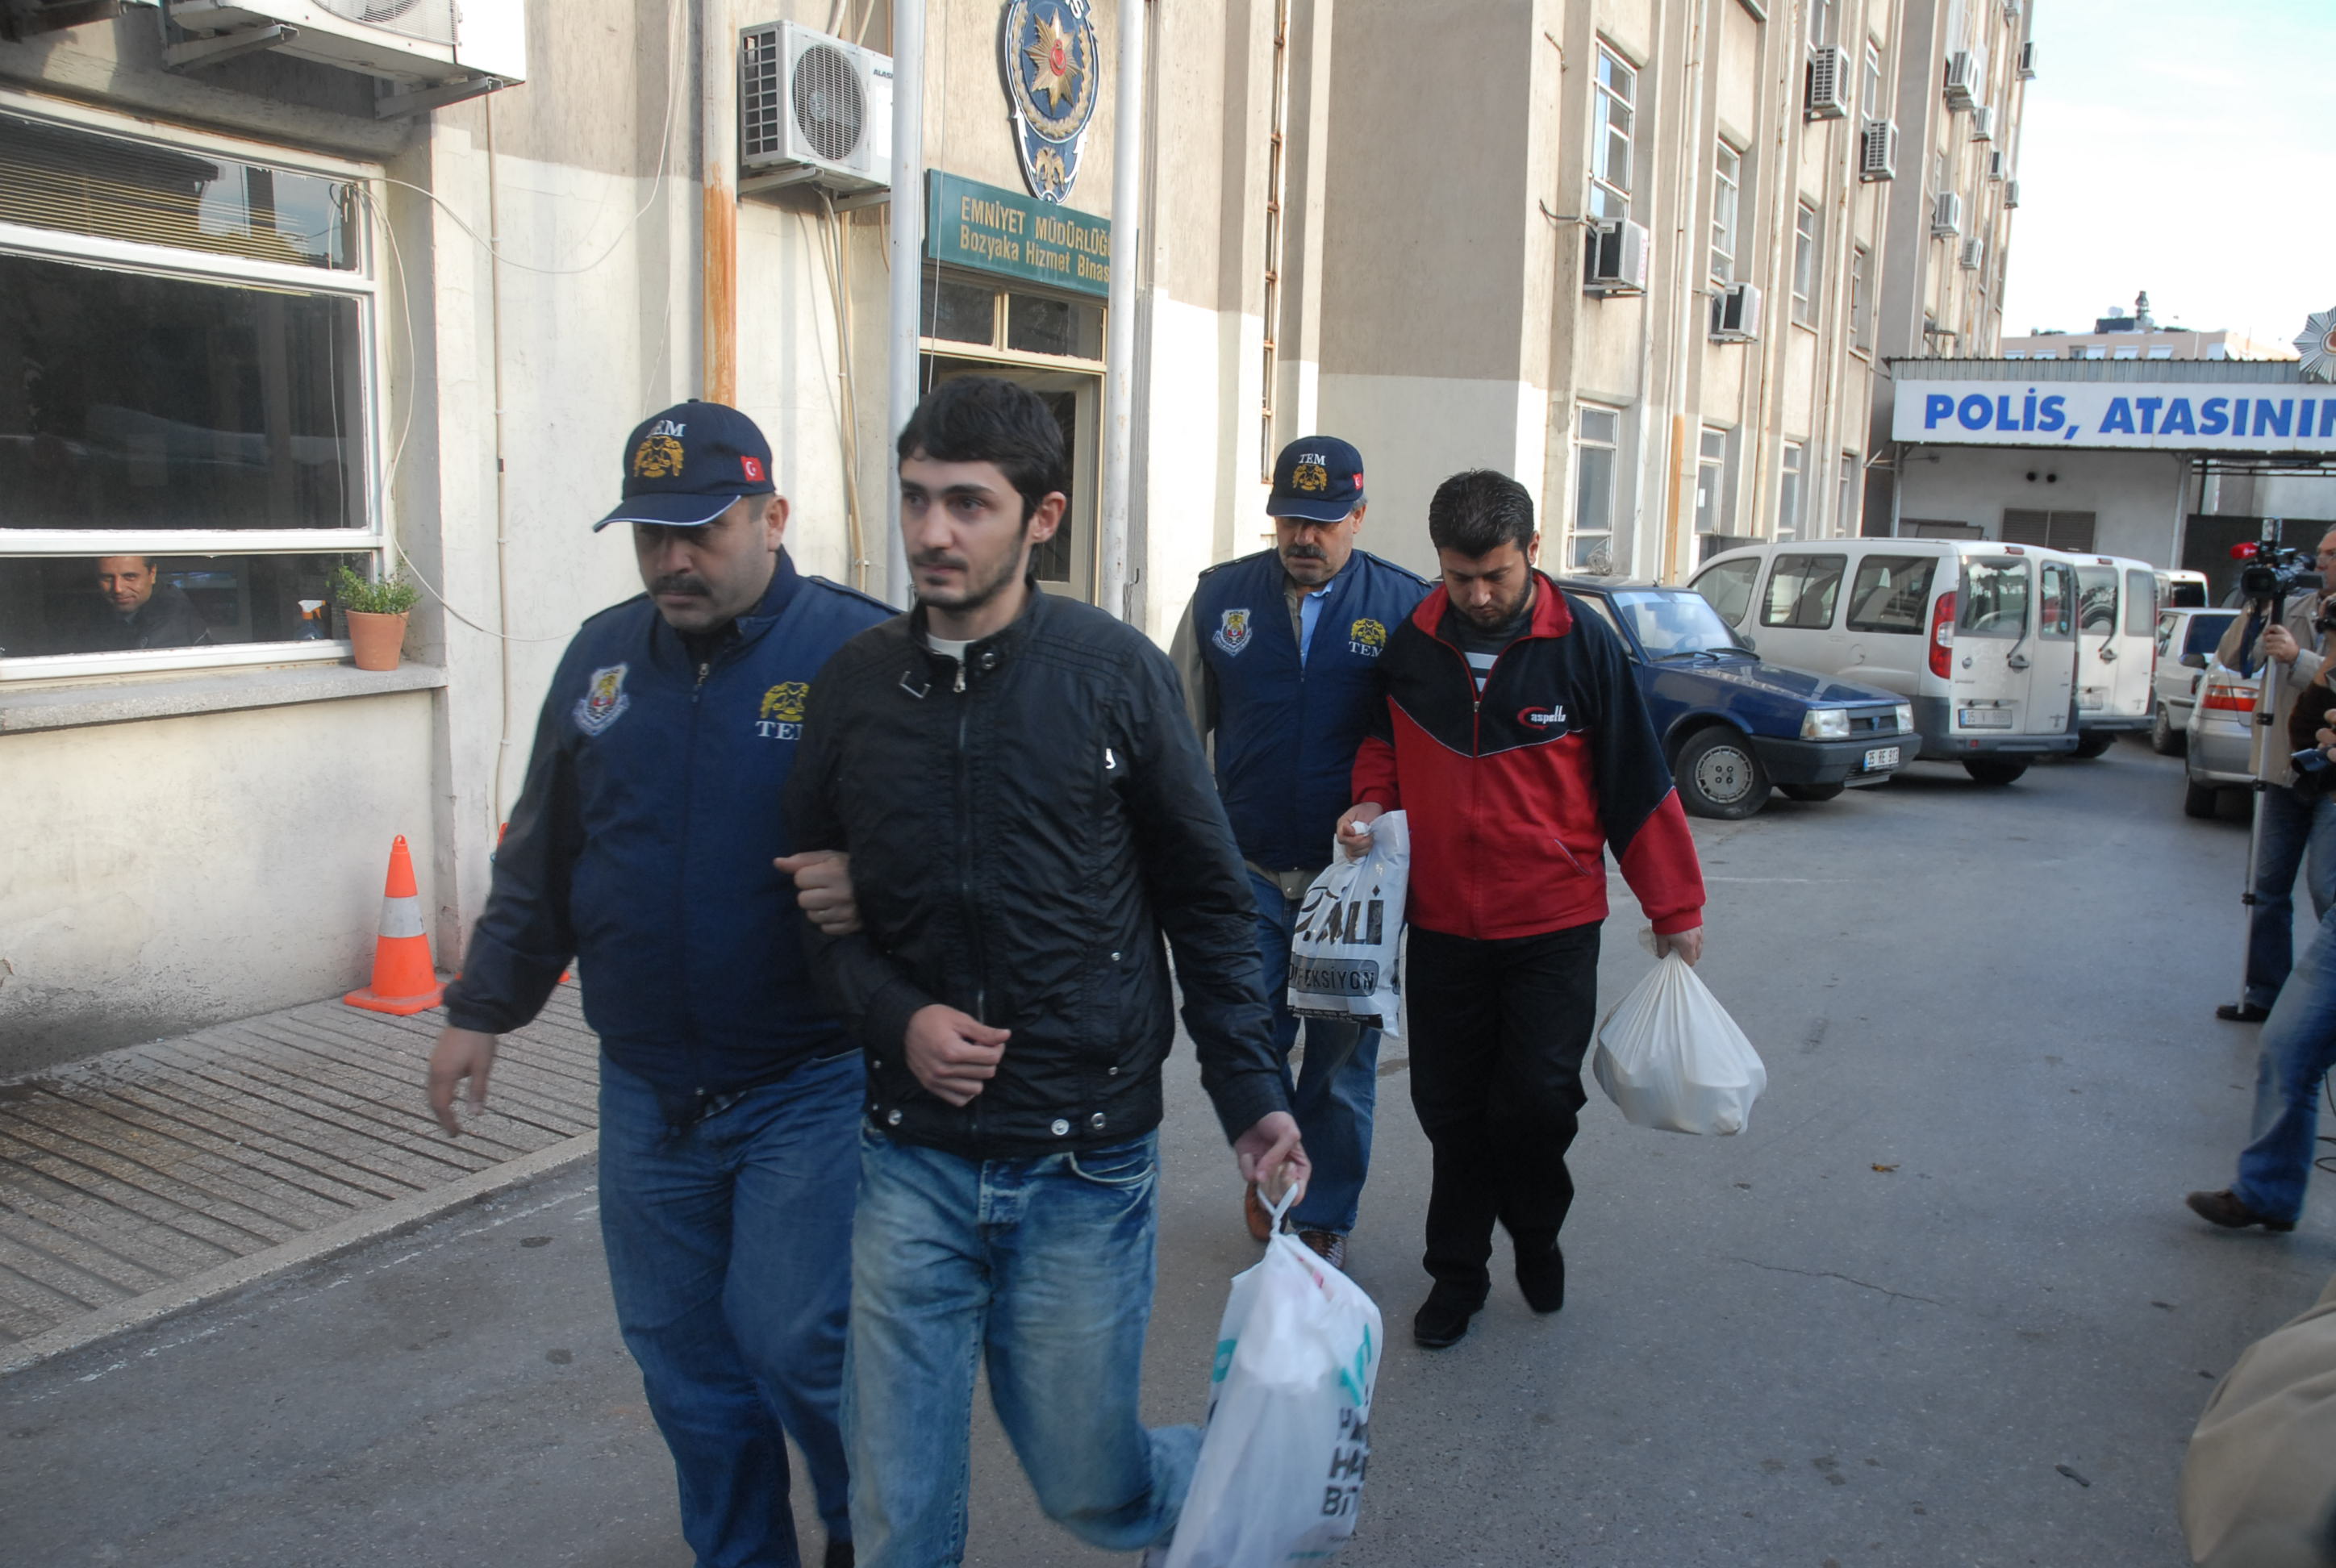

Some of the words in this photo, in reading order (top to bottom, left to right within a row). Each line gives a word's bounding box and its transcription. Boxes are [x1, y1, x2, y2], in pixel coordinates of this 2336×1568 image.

[874, 69, 893, 79] ALAS
[962, 196, 1025, 235] EMNİYET
[960, 223, 1019, 261] Bozyaka
[1026, 240, 1070, 274] Hizmet
[1924, 387, 2080, 440] POLİS,
[645, 419, 686, 438] EM
[1298, 452, 1325, 465] TEM
